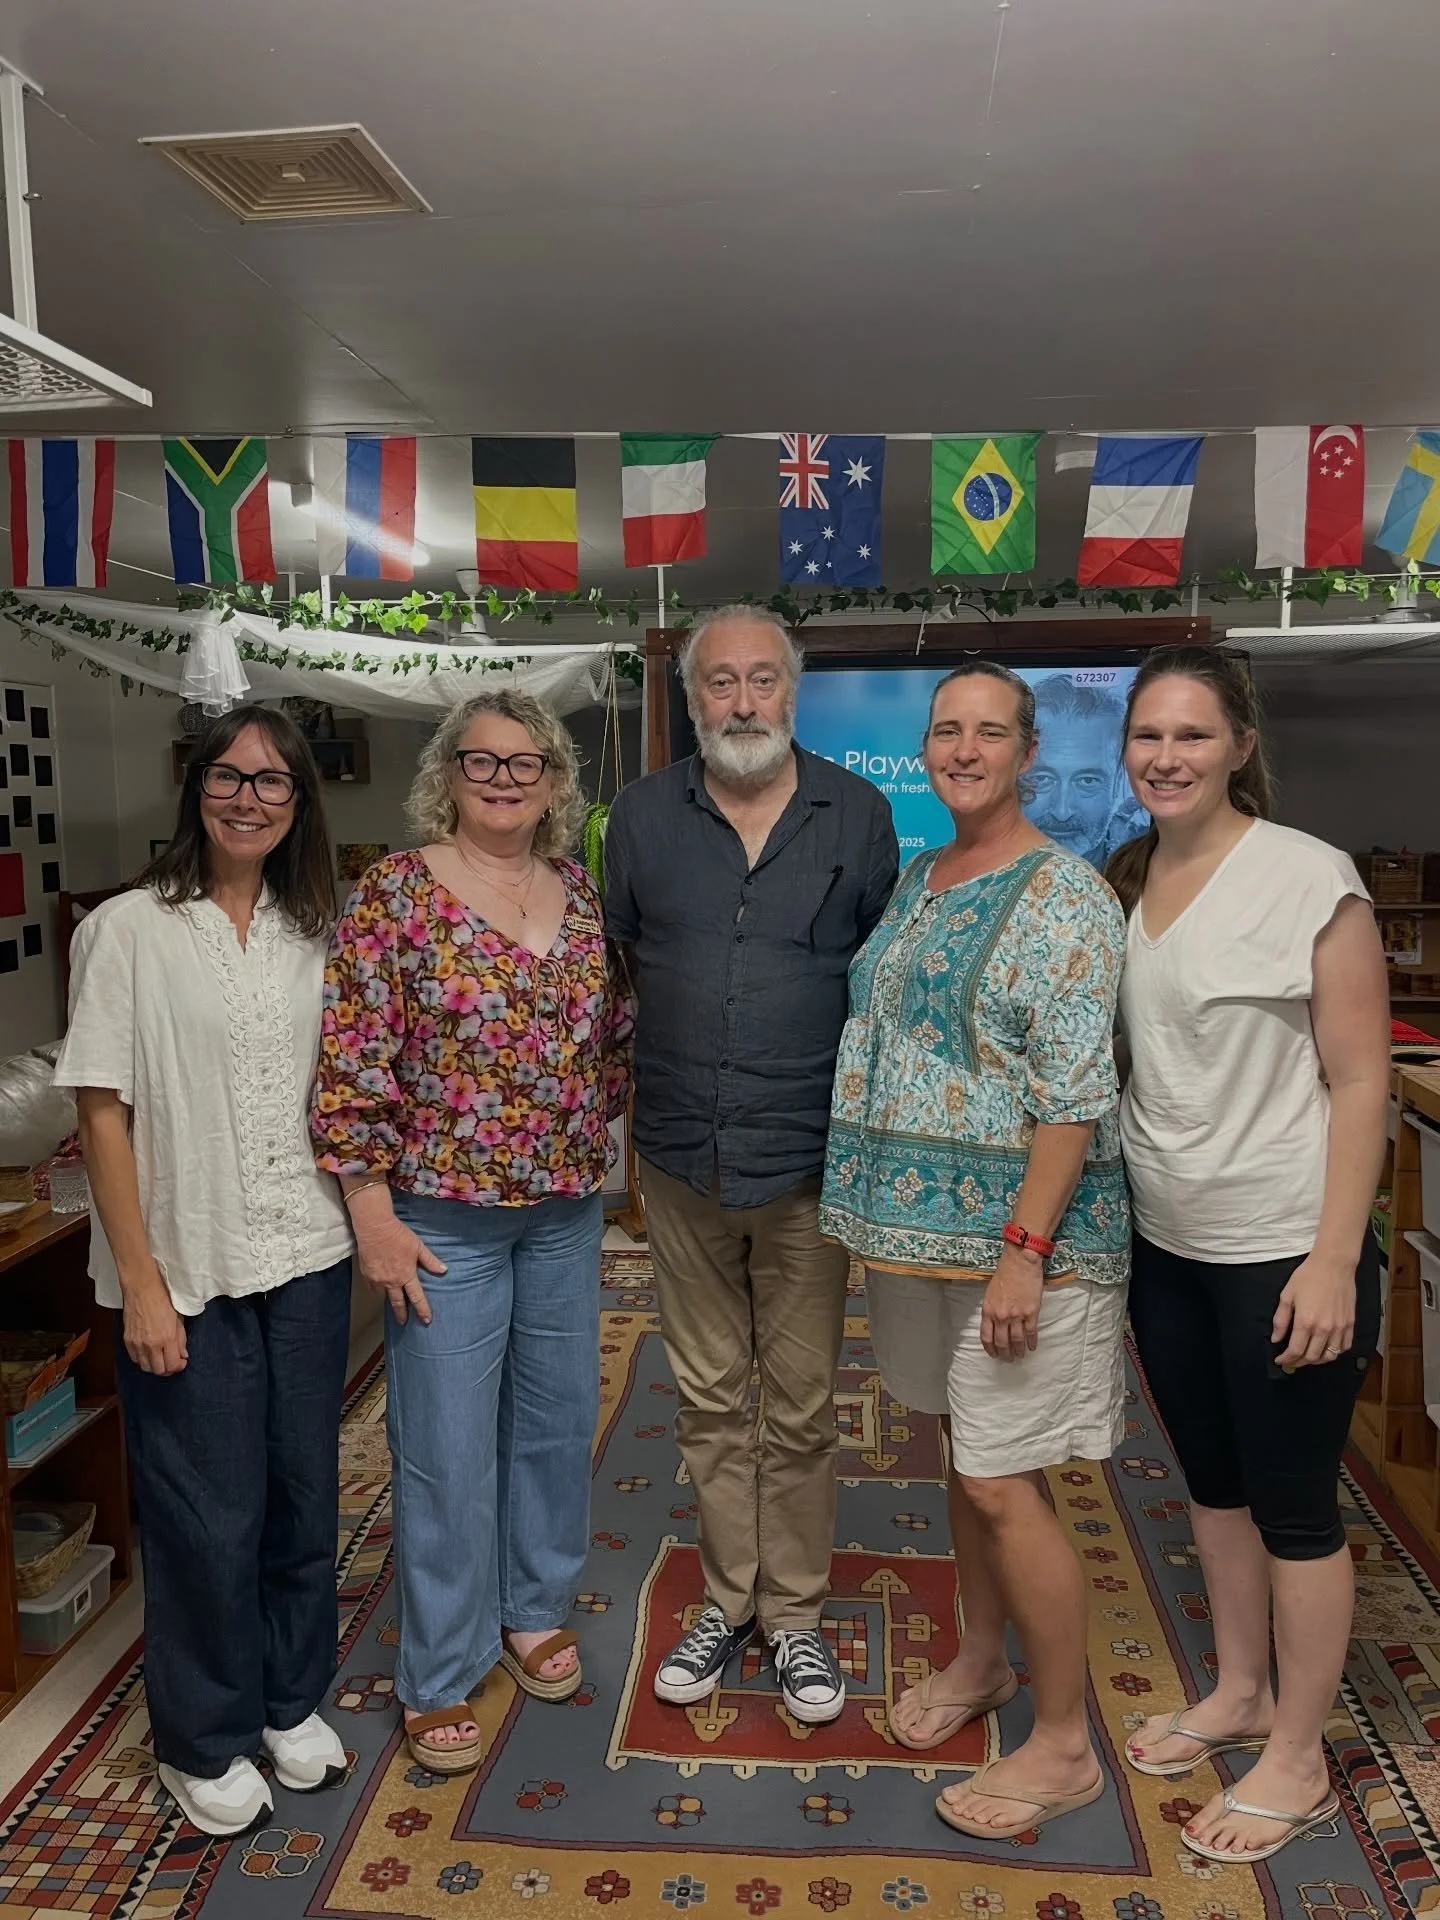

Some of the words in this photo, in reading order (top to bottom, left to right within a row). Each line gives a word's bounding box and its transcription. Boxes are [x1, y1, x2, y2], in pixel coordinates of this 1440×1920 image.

[1076, 672, 1116, 682] 672307
[901, 782, 930, 793] fresh
[899, 837, 925, 847] 2025
